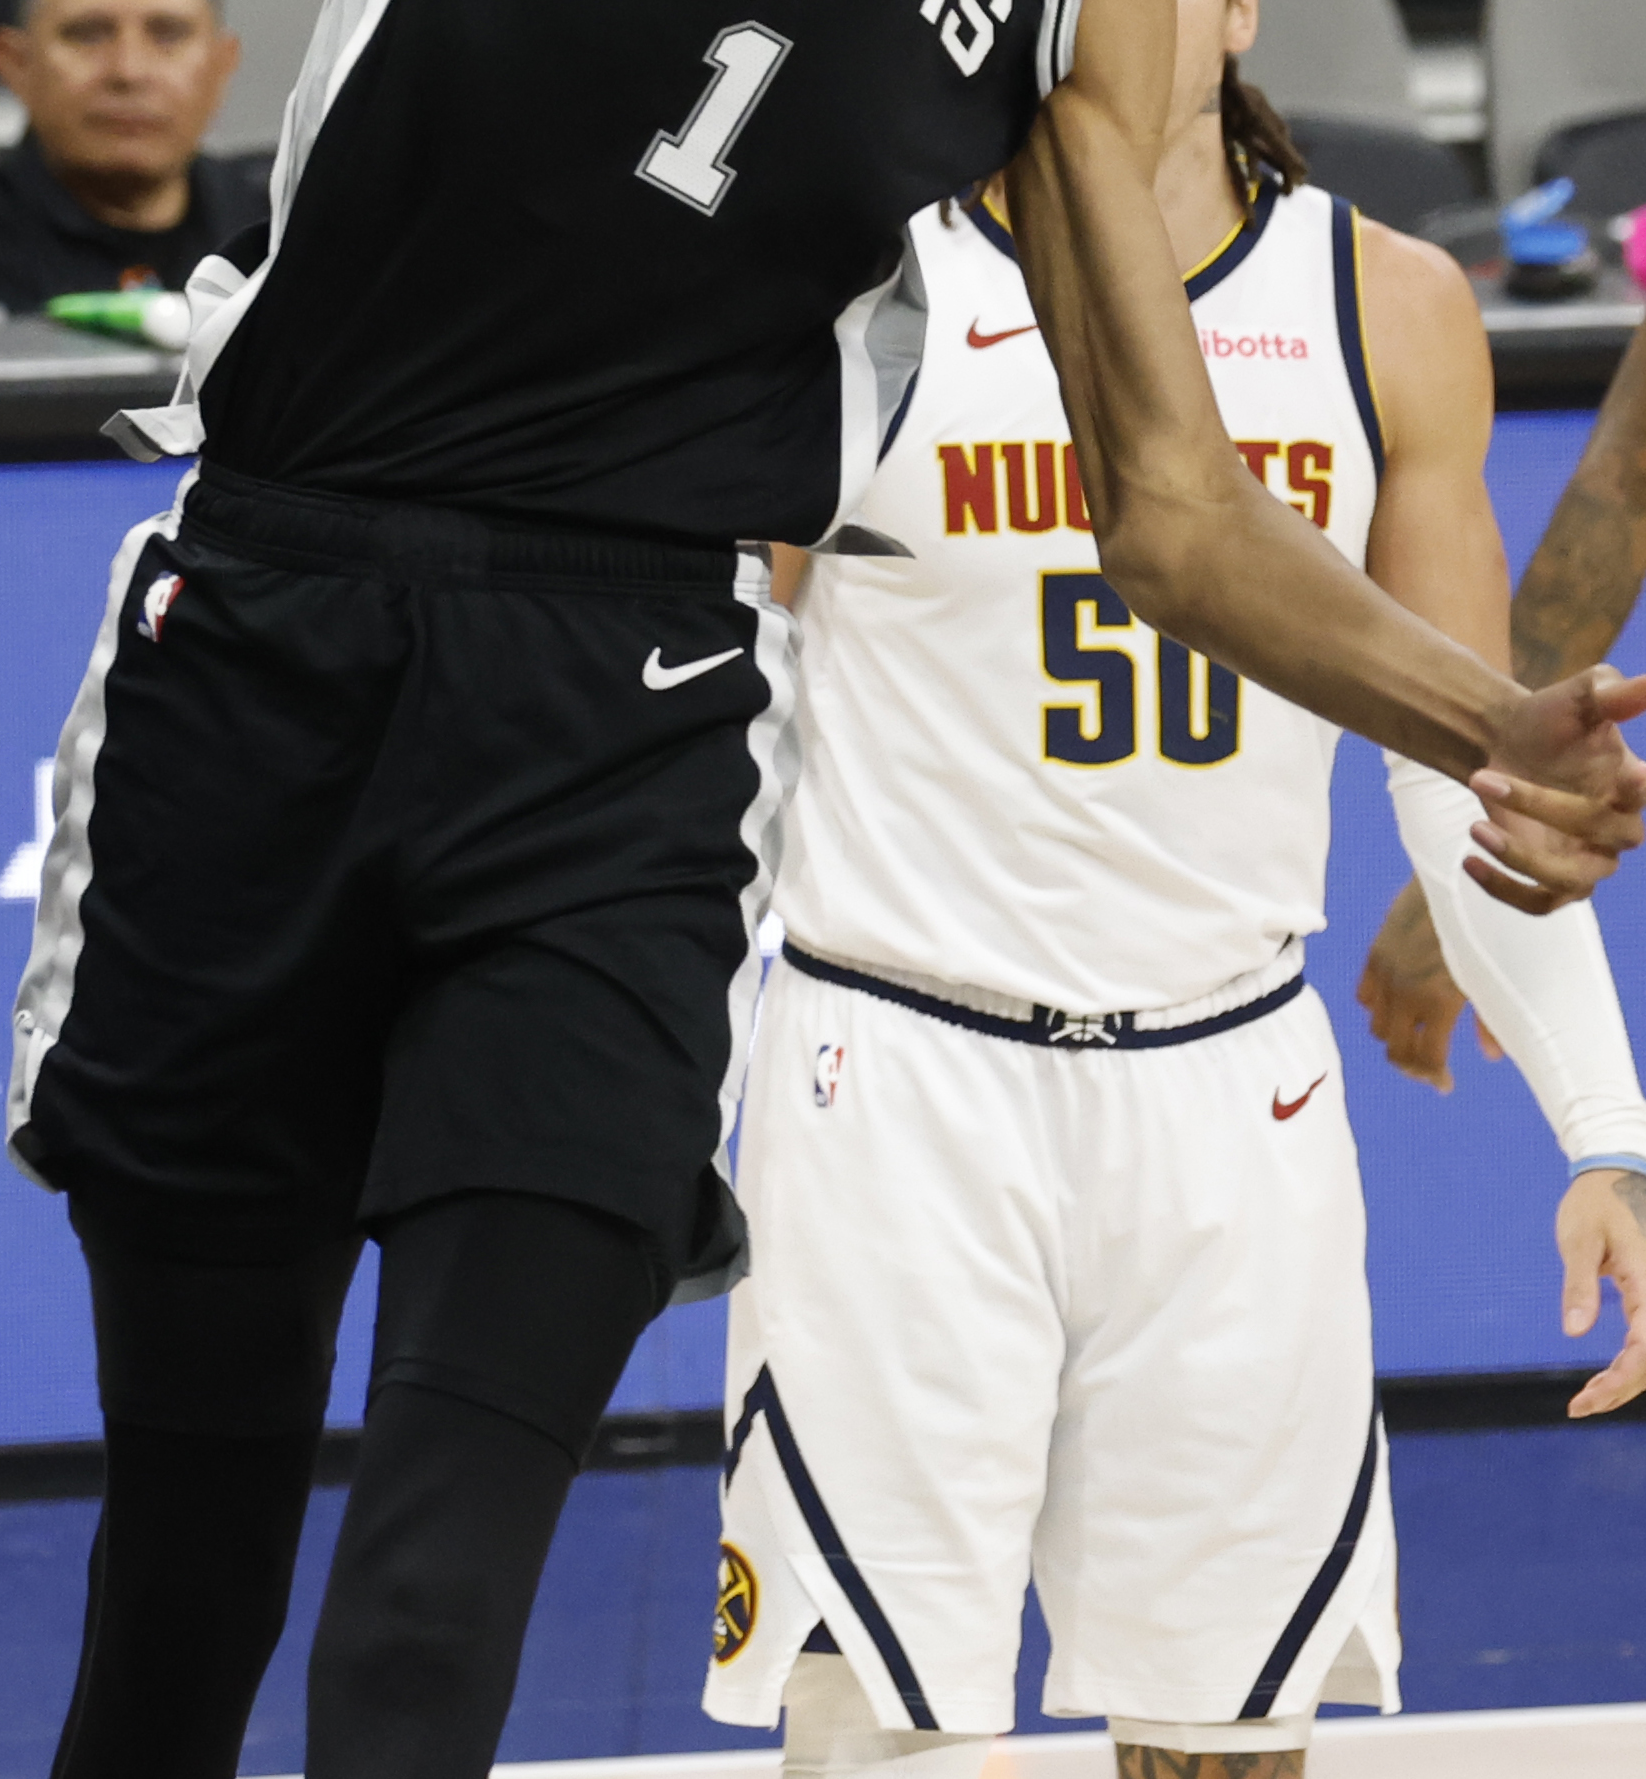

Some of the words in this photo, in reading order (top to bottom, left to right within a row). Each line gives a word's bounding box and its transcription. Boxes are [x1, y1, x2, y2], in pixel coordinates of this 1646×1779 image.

[634, 20, 794, 217] 1
[1200, 328, 1309, 360] ibotta
[937, 439, 1334, 538] NUTS
[1038, 567, 1245, 770] 50
